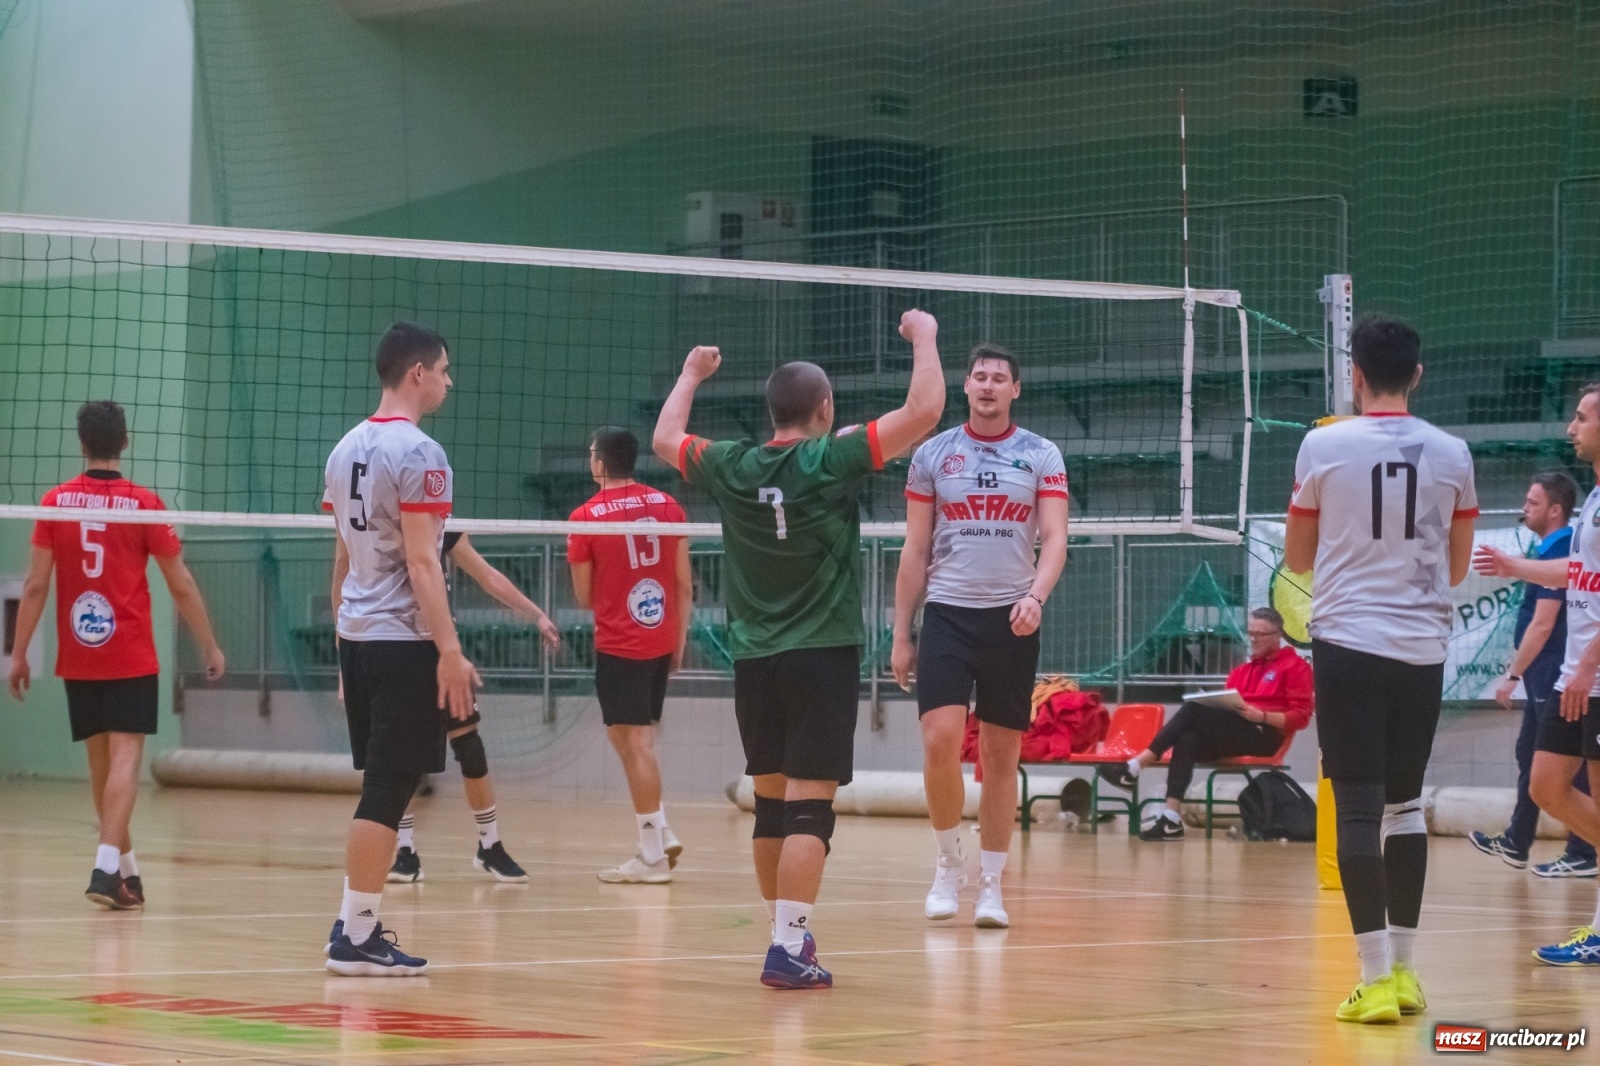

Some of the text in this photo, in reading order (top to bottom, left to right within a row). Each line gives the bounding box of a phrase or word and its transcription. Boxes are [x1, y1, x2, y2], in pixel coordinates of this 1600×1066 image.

[112, 495, 140, 510] TEAM
[349, 462, 368, 532] 5
[977, 471, 999, 489] 12
[1371, 462, 1418, 540] 17
[758, 487, 788, 540] 7
[941, 494, 1033, 523] RAFAKO
[959, 528, 1014, 538] GRUPA PBG
[80, 520, 107, 579] 5
[625, 516, 661, 570] 13
